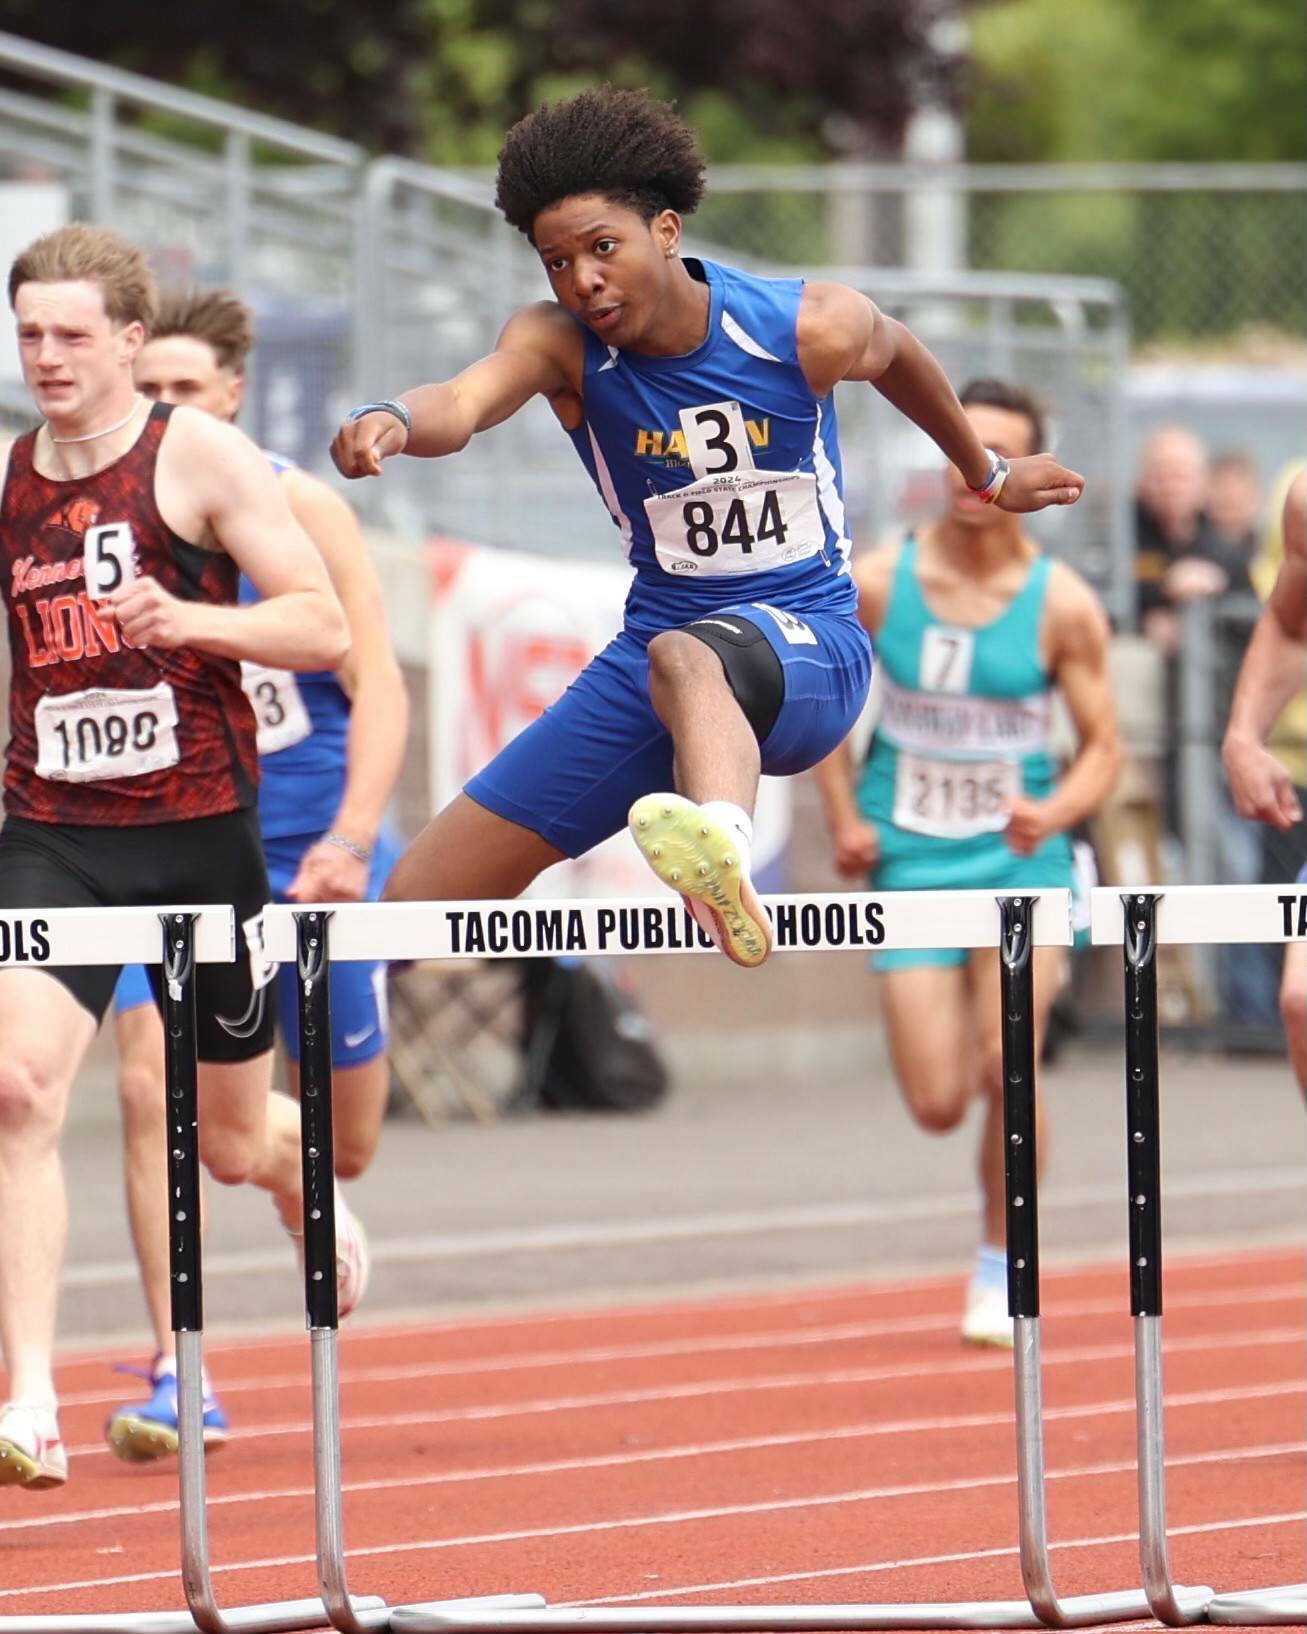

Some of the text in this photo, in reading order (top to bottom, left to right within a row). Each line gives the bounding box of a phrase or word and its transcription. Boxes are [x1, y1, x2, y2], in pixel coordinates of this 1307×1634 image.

[636, 419, 769, 458] HAN
[695, 409, 739, 475] 3
[713, 476, 741, 484] 2024
[683, 490, 788, 557] 844
[12, 555, 85, 598] Kenne
[97, 530, 122, 593] 5
[16, 591, 149, 669] LION
[938, 636, 960, 691] 7
[256, 681, 285, 726] 3
[446, 910, 587, 953] TACOMA
[764, 902, 886, 947] HOOLS
